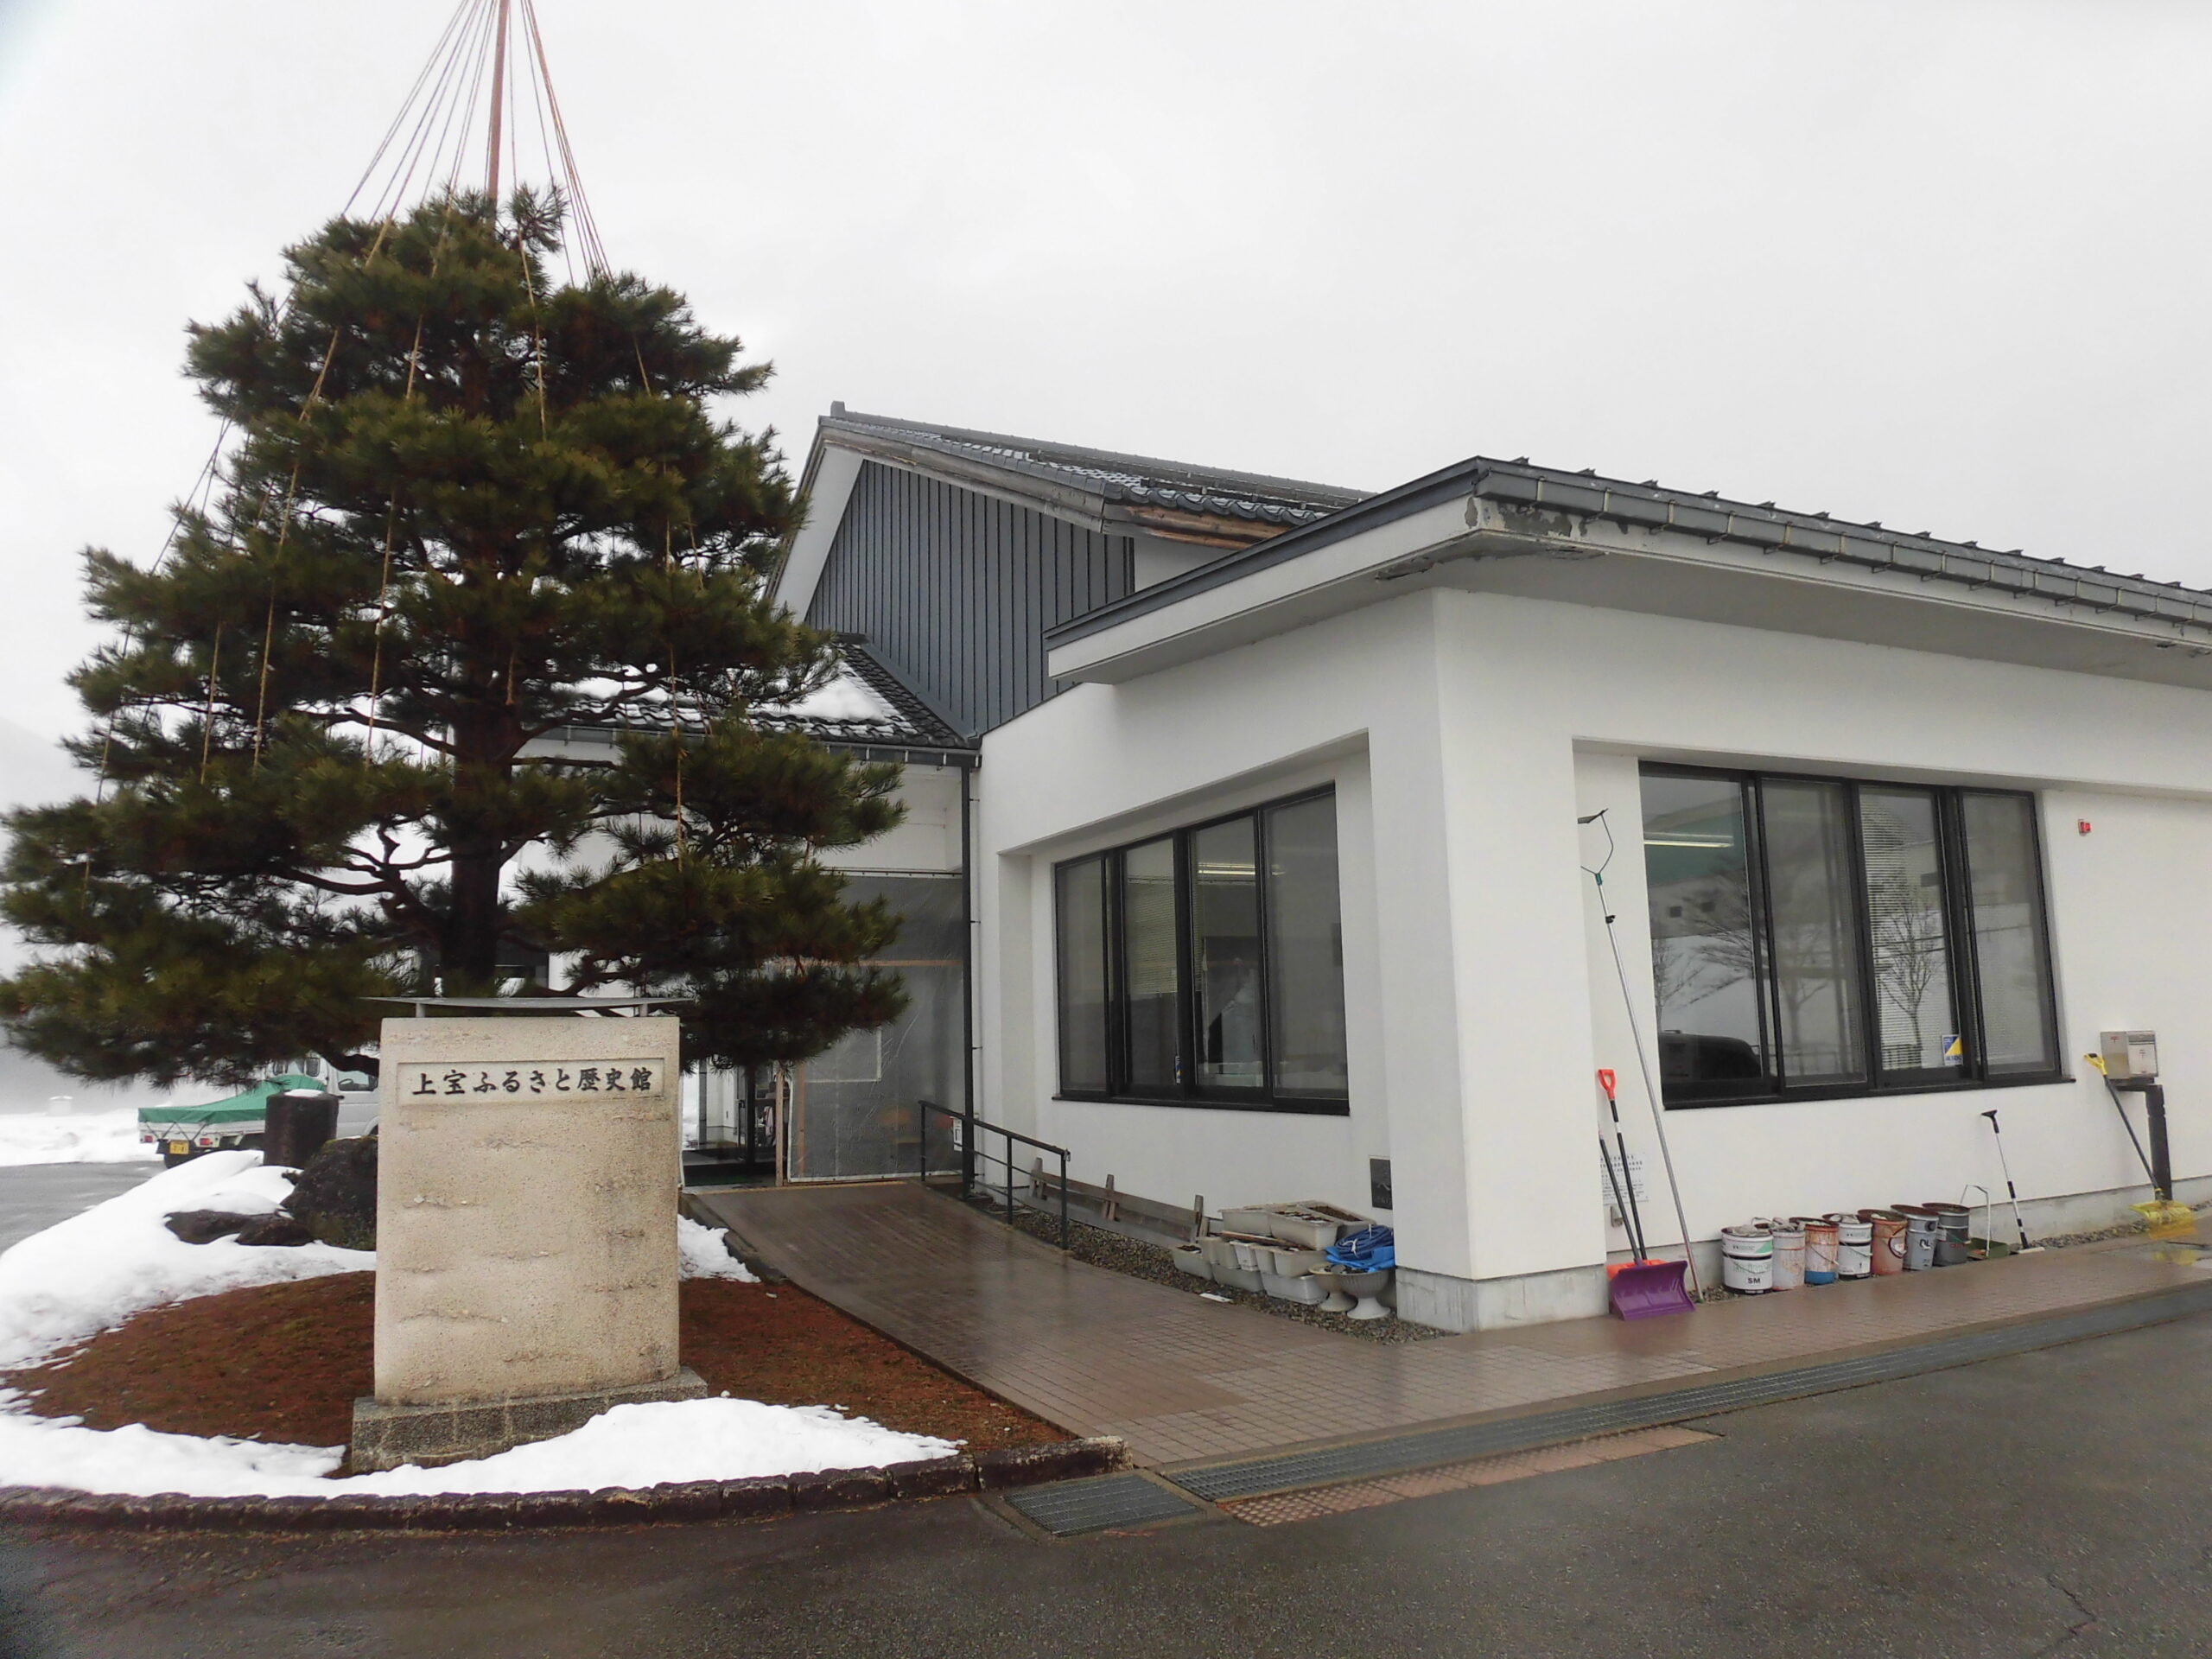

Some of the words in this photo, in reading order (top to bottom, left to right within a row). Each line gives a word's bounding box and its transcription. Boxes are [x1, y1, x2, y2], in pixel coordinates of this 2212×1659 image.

[412, 1067, 652, 1095] 上宝ふるさと歴史館
